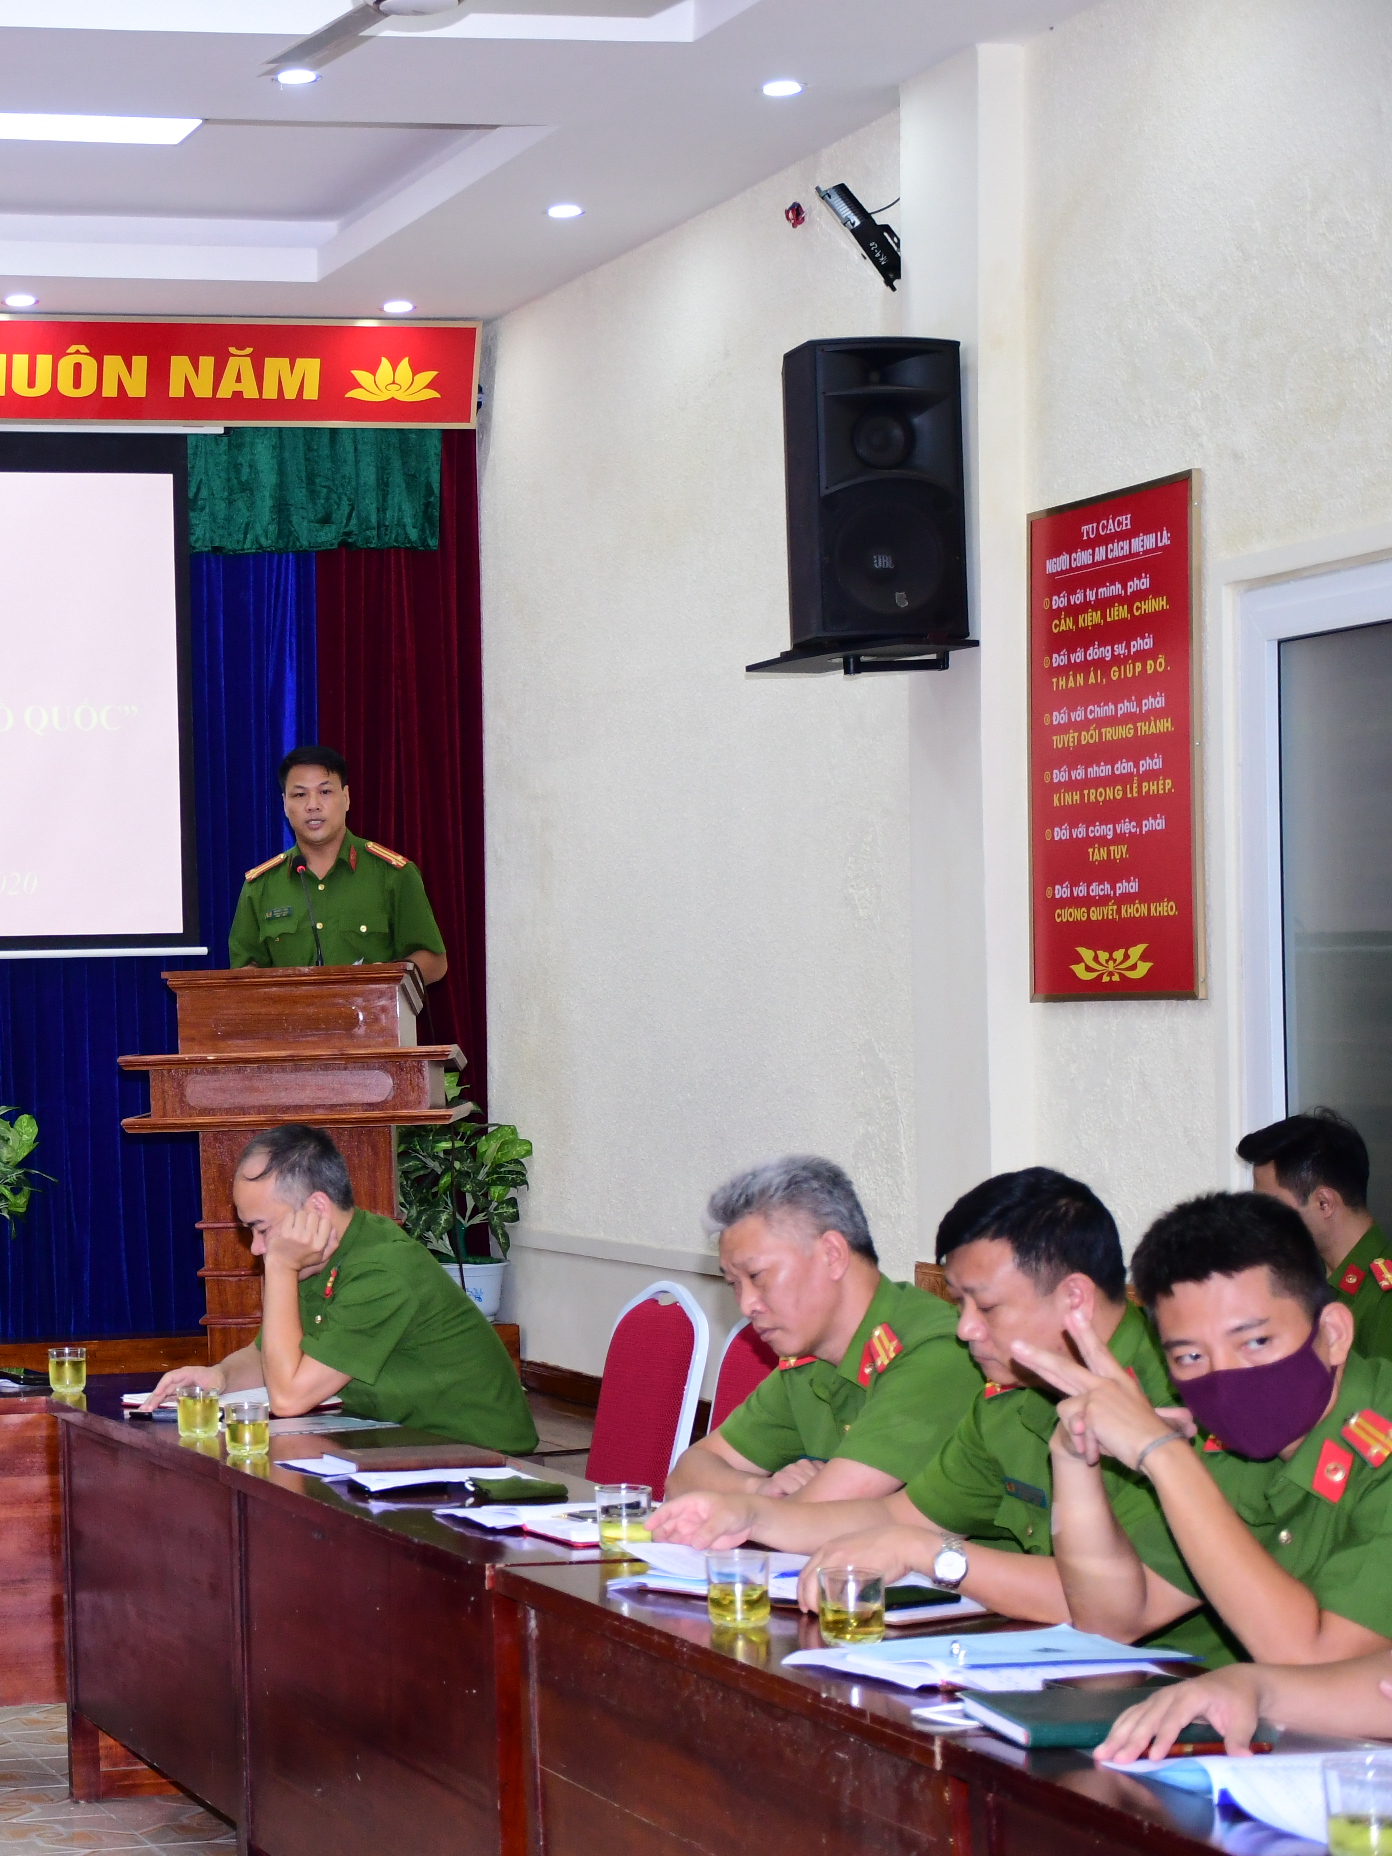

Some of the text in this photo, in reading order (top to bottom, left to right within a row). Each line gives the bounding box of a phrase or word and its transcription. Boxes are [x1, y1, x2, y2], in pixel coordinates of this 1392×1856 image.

[169, 346, 322, 401] NĂM
[1099, 514, 1131, 535] CÁCH
[1046, 552, 1070, 574] NGƯỜI
[1071, 549, 1093, 567] CÔNG
[1094, 546, 1106, 562] AN
[1108, 539, 1129, 559] CÁCH
[1131, 533, 1155, 555] MỆNH
[1052, 591, 1068, 609] Đối
[1070, 587, 1084, 605] với
[1086, 588, 1096, 605] tự
[1098, 581, 1124, 599] mình,
[1127, 573, 1150, 595] phải
[1052, 595, 1170, 633] CẦN, KIỆM, LIÊM, CHÍNH.
[1052, 649, 1068, 667] Đối
[1070, 646, 1084, 663] với
[1086, 641, 1111, 661] đồng
[1114, 641, 1128, 658] sự,
[1130, 633, 1153, 653] phải
[1052, 671, 1084, 691] THÂN
[1088, 667, 1106, 685] ÁI,
[1110, 660, 1142, 681] GIÚP
[1052, 707, 1068, 725] Đối
[1070, 704, 1084, 722] với
[1086, 702, 1115, 719] Chính
[1117, 696, 1139, 718] phủ,
[1142, 692, 1165, 713] phải
[1052, 716, 1175, 750] TUYỆT ĐỐI TRUNG THÀNH.
[1053, 765, 1068, 783] Đối
[1071, 763, 1085, 780] với
[1087, 762, 1112, 778] nhân
[1114, 759, 1136, 775] dân,
[1139, 753, 1163, 774] phải
[1053, 776, 1175, 807] KÍNH TRỌNG LỄ PHÉP.
[1054, 823, 1070, 841] Đối
[1072, 823, 1086, 839] với
[1088, 822, 1114, 839] công
[1116, 818, 1140, 837] việc,
[1142, 814, 1166, 834] phải
[1088, 843, 1129, 865] TẬN TỤY.
[1054, 881, 1070, 899] Đối
[1073, 880, 1087, 897] với
[1089, 881, 1114, 900] địch,
[1116, 876, 1139, 896] phải
[1055, 898, 1178, 923] CƯƠNG QUYẾT, KHÔN KHÉO.
